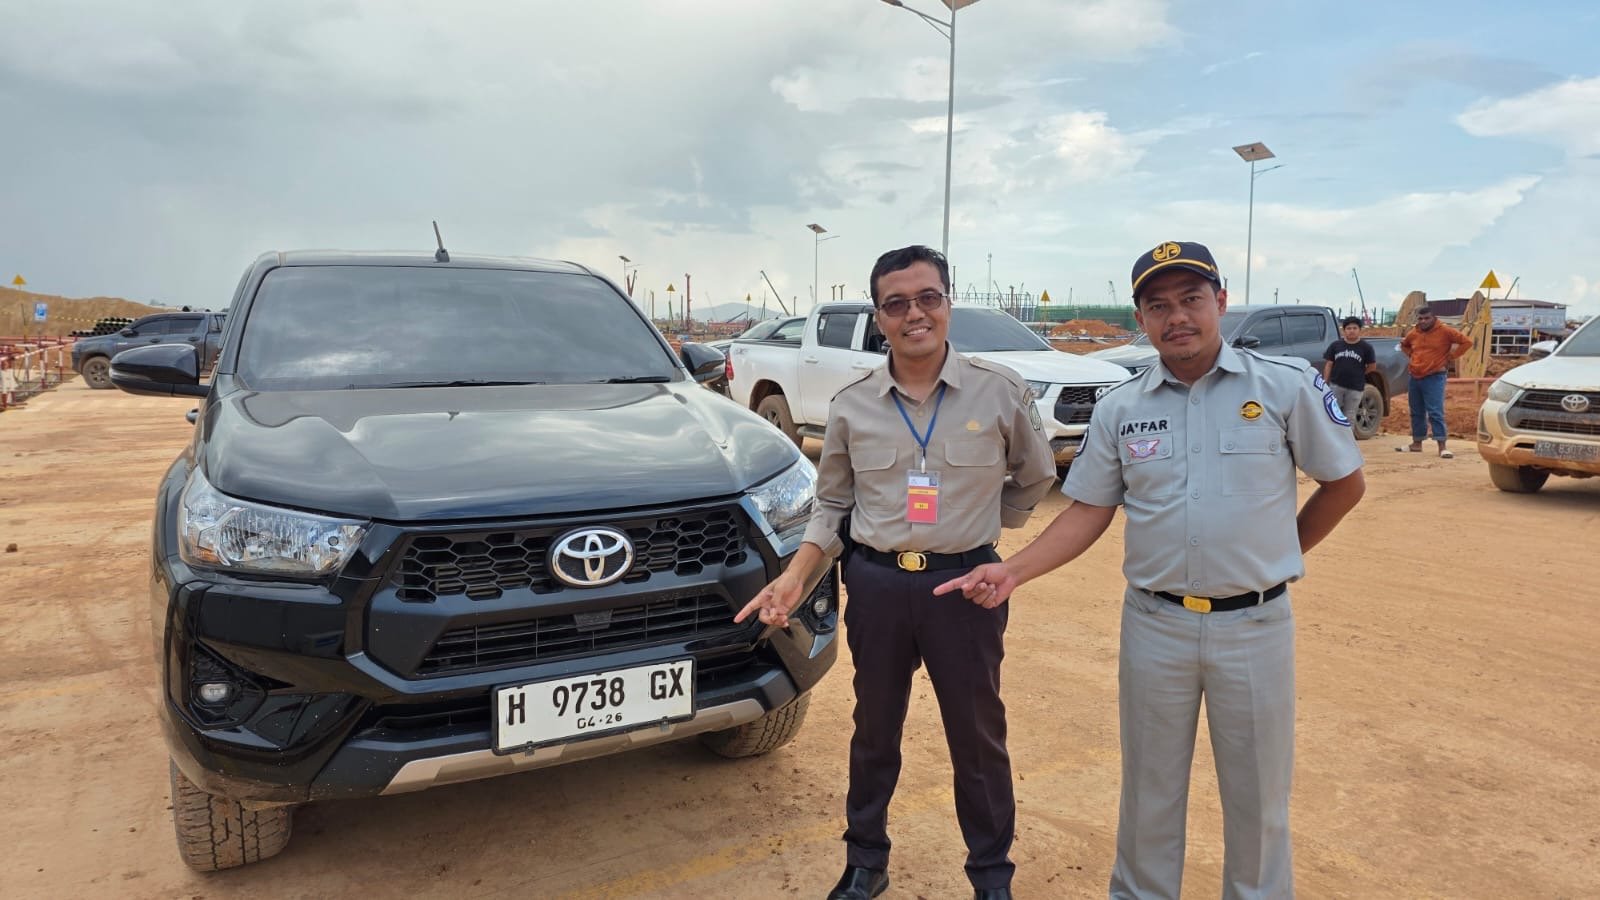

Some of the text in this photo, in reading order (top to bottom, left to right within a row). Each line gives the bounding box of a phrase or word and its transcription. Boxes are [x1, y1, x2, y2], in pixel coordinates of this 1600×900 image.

[1120, 419, 1168, 436] JA'FAR
[509, 666, 685, 725] H 9738 GX
